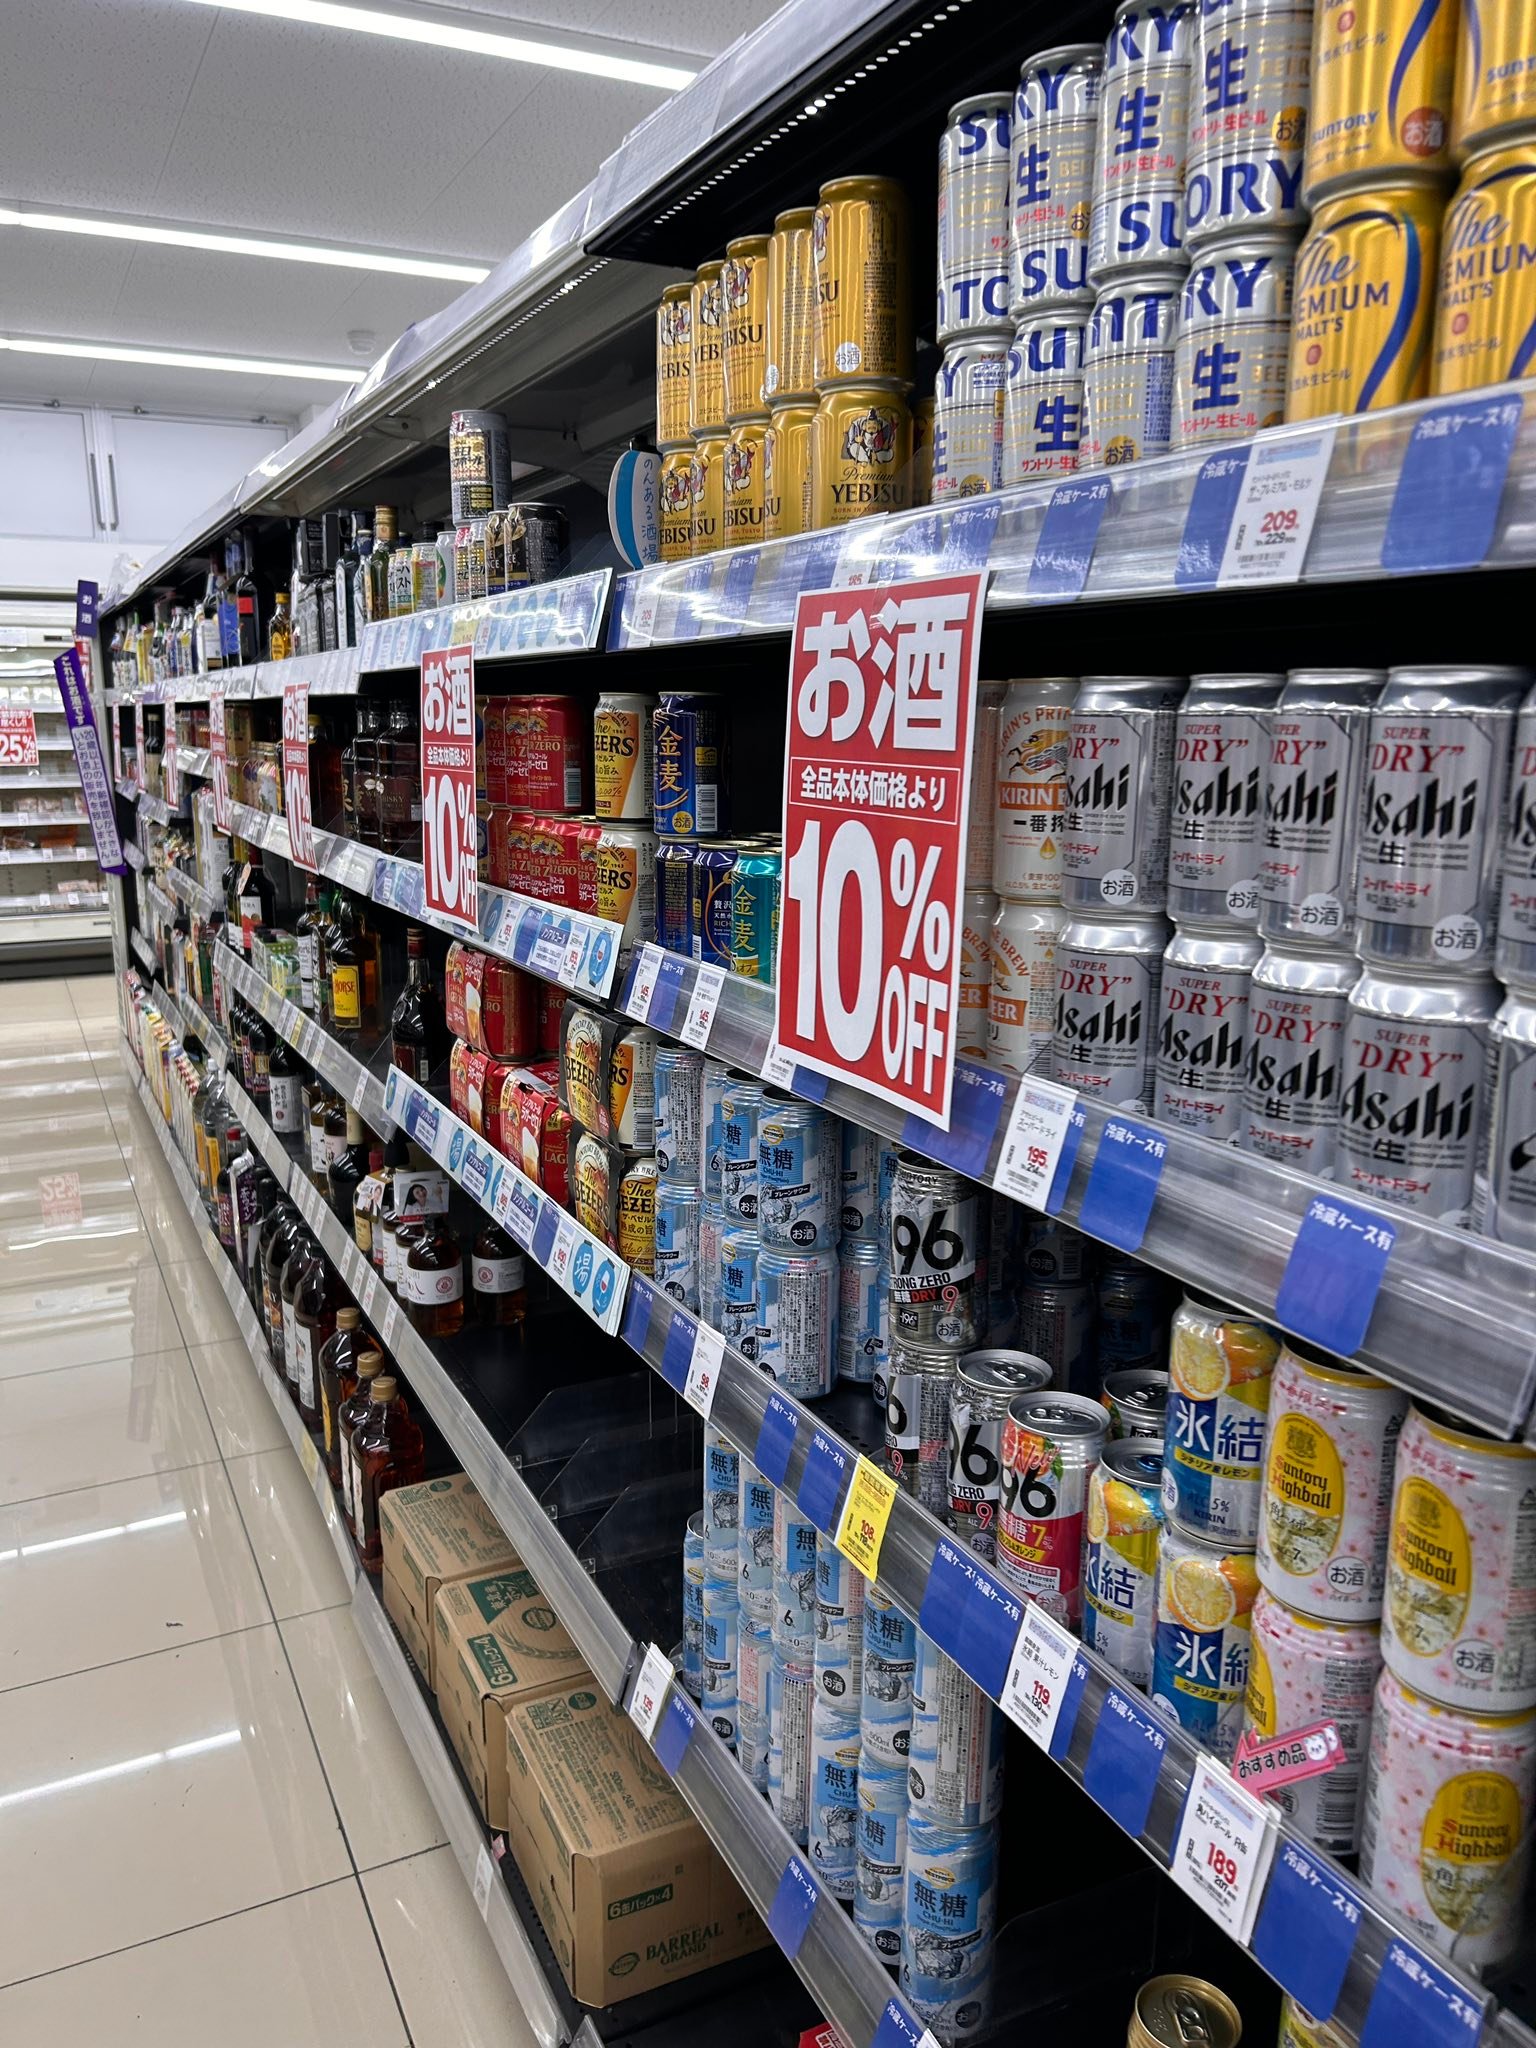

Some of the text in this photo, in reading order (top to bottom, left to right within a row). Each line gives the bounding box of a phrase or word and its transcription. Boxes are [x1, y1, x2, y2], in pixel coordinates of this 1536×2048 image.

[1203, 37, 1250, 118] 生
[1114, 86, 1162, 157] 生
[1404, 120, 1444, 148] お酒
[1016, 143, 1052, 208] 生
[836, 349, 861, 366] お酒
[1192, 343, 1241, 411] 生
[1034, 394, 1079, 453] 生
[1415, 403, 1522, 442] 冷蔵ケース有
[841, 465, 894, 482] Premium
[830, 483, 905, 504] YEBISU
[1052, 483, 1111, 508] 冷蔵ケース有
[1261, 509, 1298, 534] 209
[798, 593, 970, 752] お酒
[423, 652, 472, 738] お酒
[1184, 724, 1222, 736] SUPER
[1382, 726, 1431, 740] SUPER
[427, 744, 471, 769] 全品本体価格より
[657, 725, 683, 792] 金麦
[801, 764, 946, 813] 全品本体価格より
[1001, 787, 1053, 806] KIRIN
[1183, 819, 1205, 841] 生
[1266, 826, 1283, 848] 生
[1379, 841, 1407, 866] 生
[1102, 879, 1136, 897] お酒
[734, 884, 757, 952] 金麦
[1301, 906, 1340, 927] お酒
[1433, 927, 1479, 951] お酒
[1069, 959, 1107, 972] SUPER
[1178, 977, 1222, 992] SUPER
[1265, 999, 1313, 1016] SUPER
[881, 964, 949, 1095] OFF
[1374, 1028, 1432, 1048] SUPER
[1070, 1044, 1092, 1065] 生
[957, 1069, 1007, 1097] 冷蔵ケース有
[1056, 1069, 1112, 1088] スーパードライ
[1178, 1068, 1205, 1091] 生
[1162, 1093, 1226, 1116] スーパードライ
[1264, 1096, 1292, 1122] 生
[1340, 1070, 1476, 1142] Asahi
[1104, 1121, 1168, 1159] 冷蔵ケース有
[1248, 1124, 1315, 1150] スーパードライ
[759, 1142, 794, 1172] 無糖
[1027, 1145, 1048, 1167] 195
[1372, 1137, 1406, 1165] 生
[774, 1186, 810, 1199] プレーンサワー
[1351, 1167, 1433, 1196] スーパードライ
[791, 1226, 816, 1242] お酒
[1308, 1199, 1396, 1252] 冷蔵ケース有
[894, 1208, 964, 1276] 96
[918, 1271, 951, 1288] ZERO
[911, 1289, 937, 1303] DRY
[937, 1321, 962, 1338] お酒
[768, 1395, 799, 1427] 冷蔵ケース有
[1175, 1399, 1267, 1463] 氷結
[812, 1433, 847, 1469] 冷蔵ケース有
[1180, 1452, 1251, 1479] シチリア産レモン
[1274, 1456, 1329, 1491] Suntory
[958, 1484, 985, 1500] ZERO
[1270, 1471, 1333, 1511] Highball
[1211, 1498, 1231, 1513] 5%
[861, 1518, 874, 1541] 108
[972, 1537, 996, 1555] お酒
[1398, 1521, 1454, 1565] Suntory
[1330, 1566, 1366, 1587] お酒
[1396, 1541, 1458, 1587] Highball
[974, 1574, 1022, 1622] 冷蔵ケース有
[864, 1610, 905, 1644] 無糖
[1456, 1647, 1496, 1674] お酒
[822, 1677, 844, 1693] お酒
[1033, 1680, 1051, 1706] 119
[1107, 1690, 1168, 1752] 冷蔵ケース有
[1237, 1742, 1307, 1779] おすすめ品
[1207, 1841, 1238, 1886] 189
[788, 1858, 819, 1904] 冷蔵ケース有
[1281, 1845, 1362, 1926] 冷蔵ケース有
[914, 1880, 969, 1920] 無糖
[922, 1909, 954, 1927] CHU-HI
[645, 1922, 725, 1962] BARREAL
[875, 1934, 900, 1951] お酒
[1388, 1942, 1482, 2032] 冷蔵ケース有
